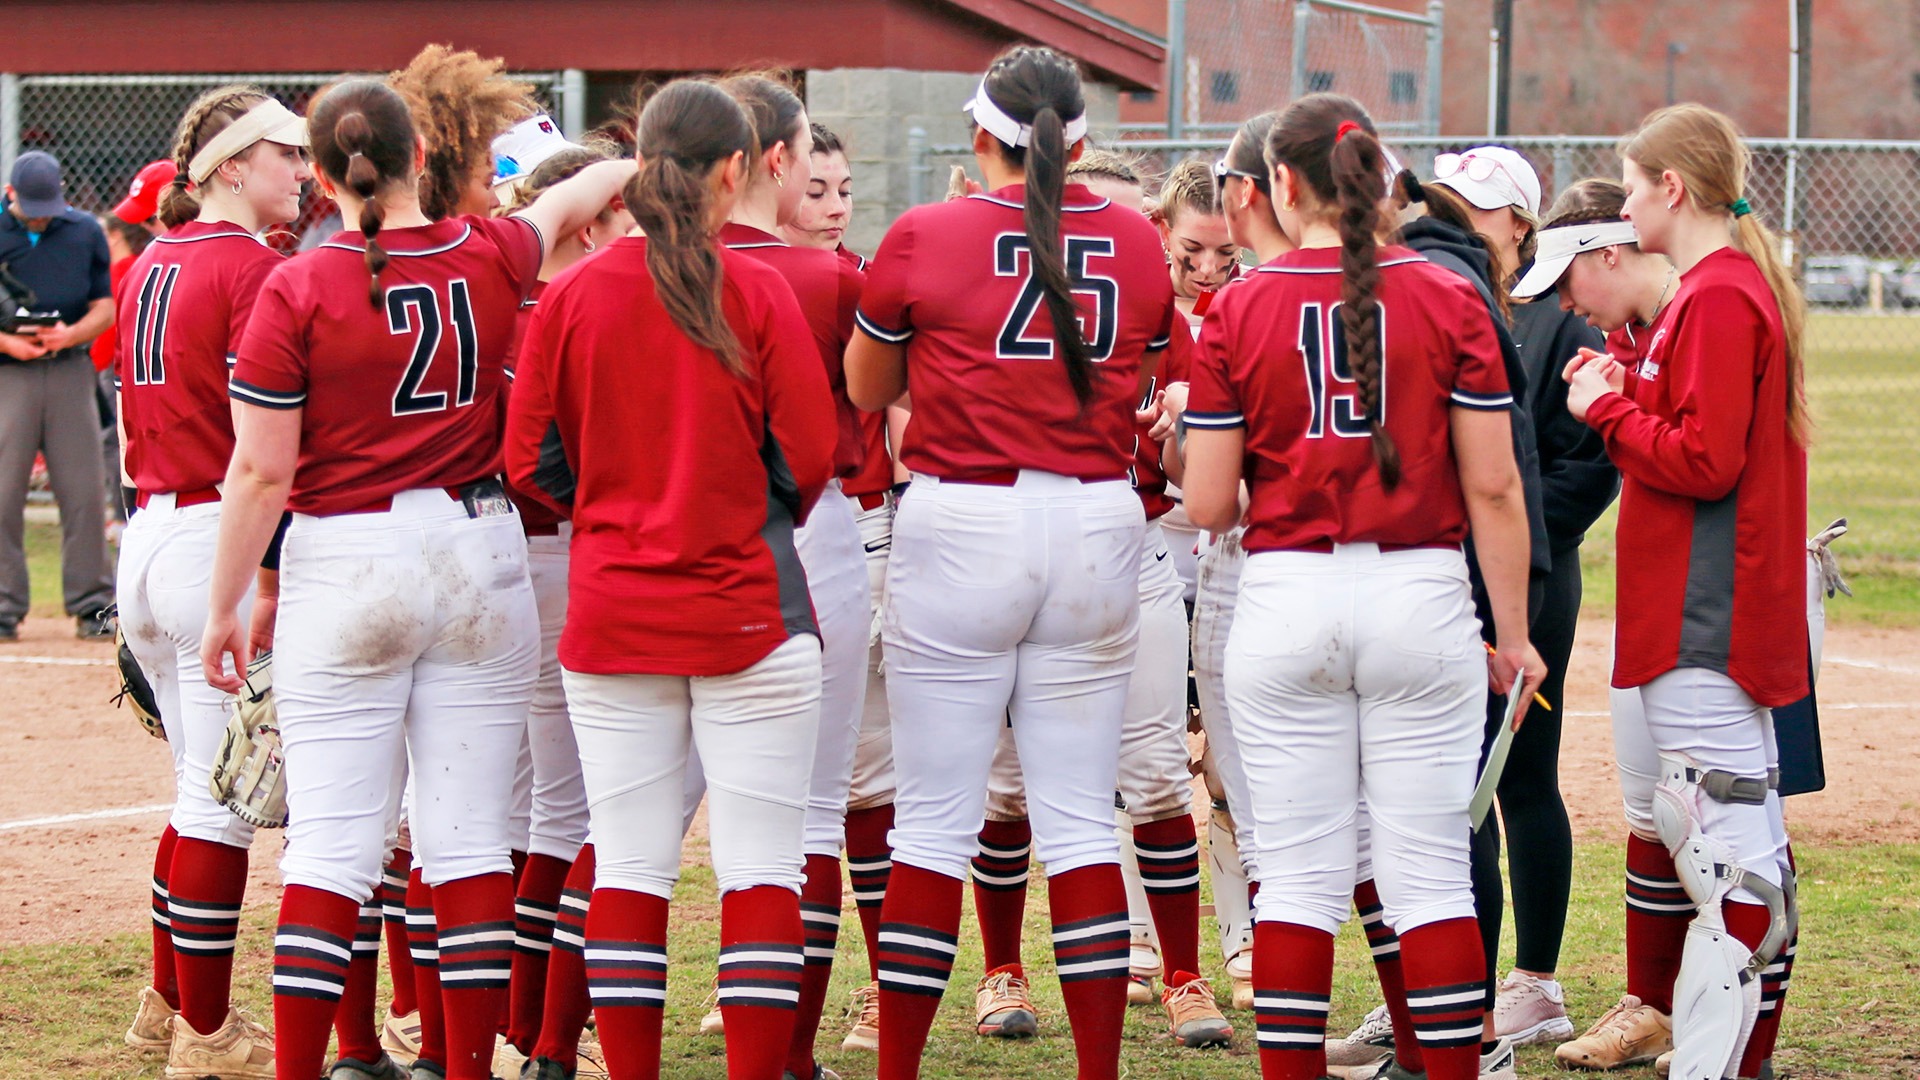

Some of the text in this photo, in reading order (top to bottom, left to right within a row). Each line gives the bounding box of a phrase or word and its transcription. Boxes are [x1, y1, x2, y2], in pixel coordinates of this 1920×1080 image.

[134, 264, 181, 385] 11
[386, 278, 478, 417] 21
[994, 231, 1119, 362] 25
[1298, 300, 1385, 438] 19
